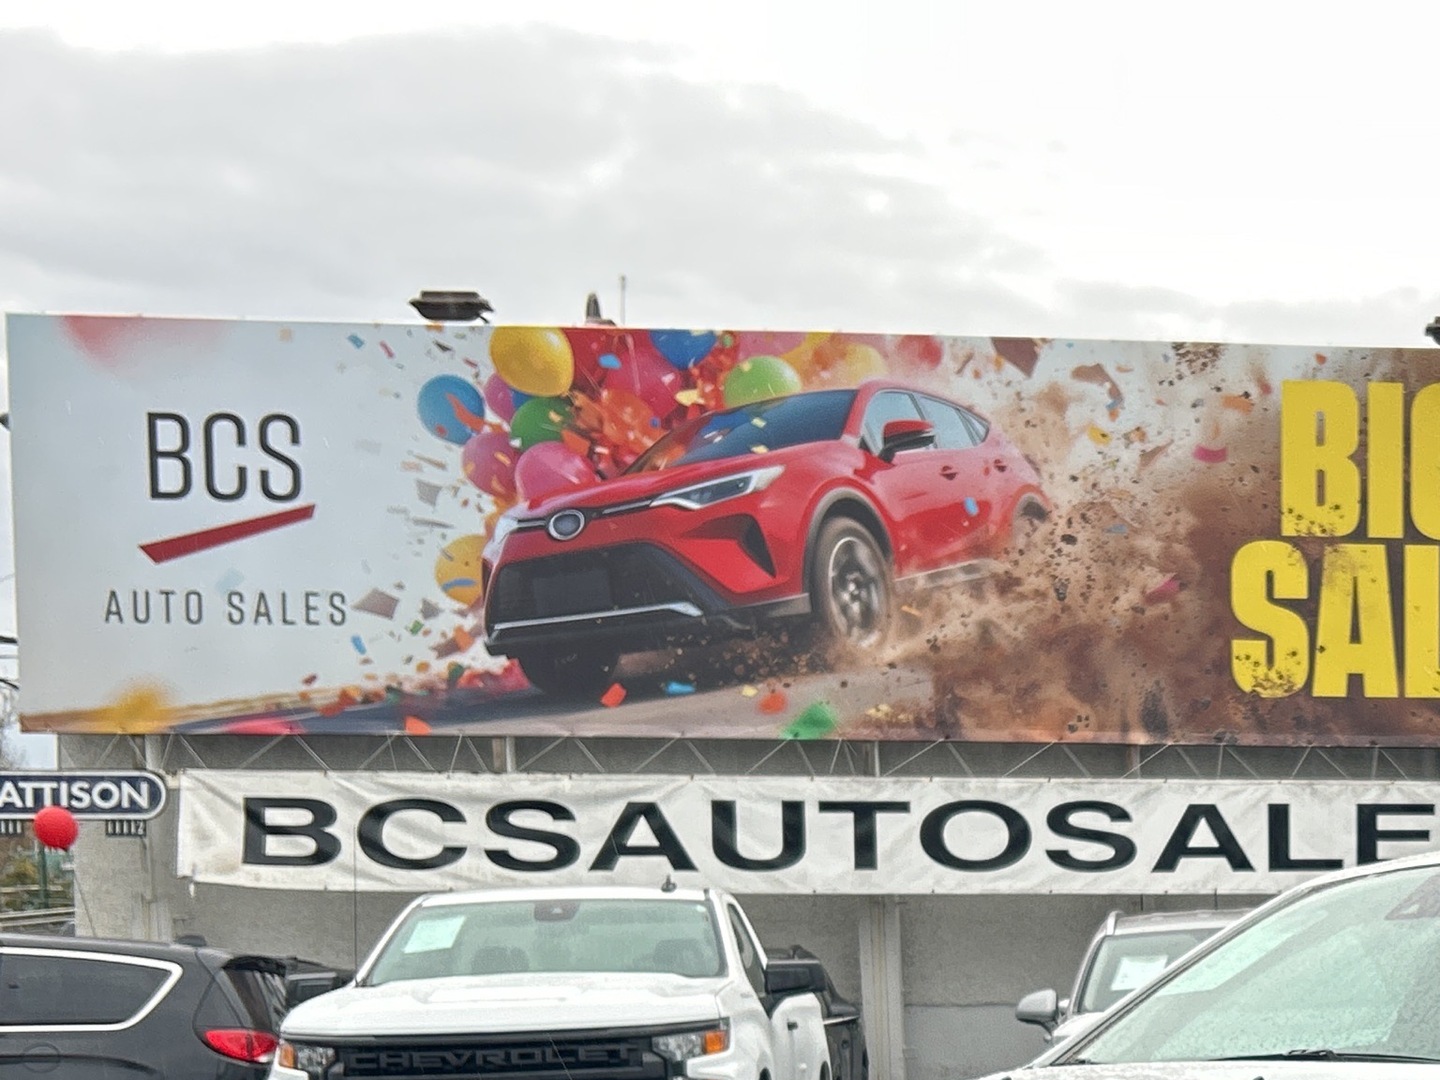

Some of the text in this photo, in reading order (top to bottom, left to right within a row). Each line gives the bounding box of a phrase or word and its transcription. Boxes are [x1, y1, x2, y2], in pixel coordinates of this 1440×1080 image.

[146, 410, 304, 503] BCS
[104, 589, 348, 627] AUTO SALES
[350, 1044, 640, 1070] CHEVROLET
